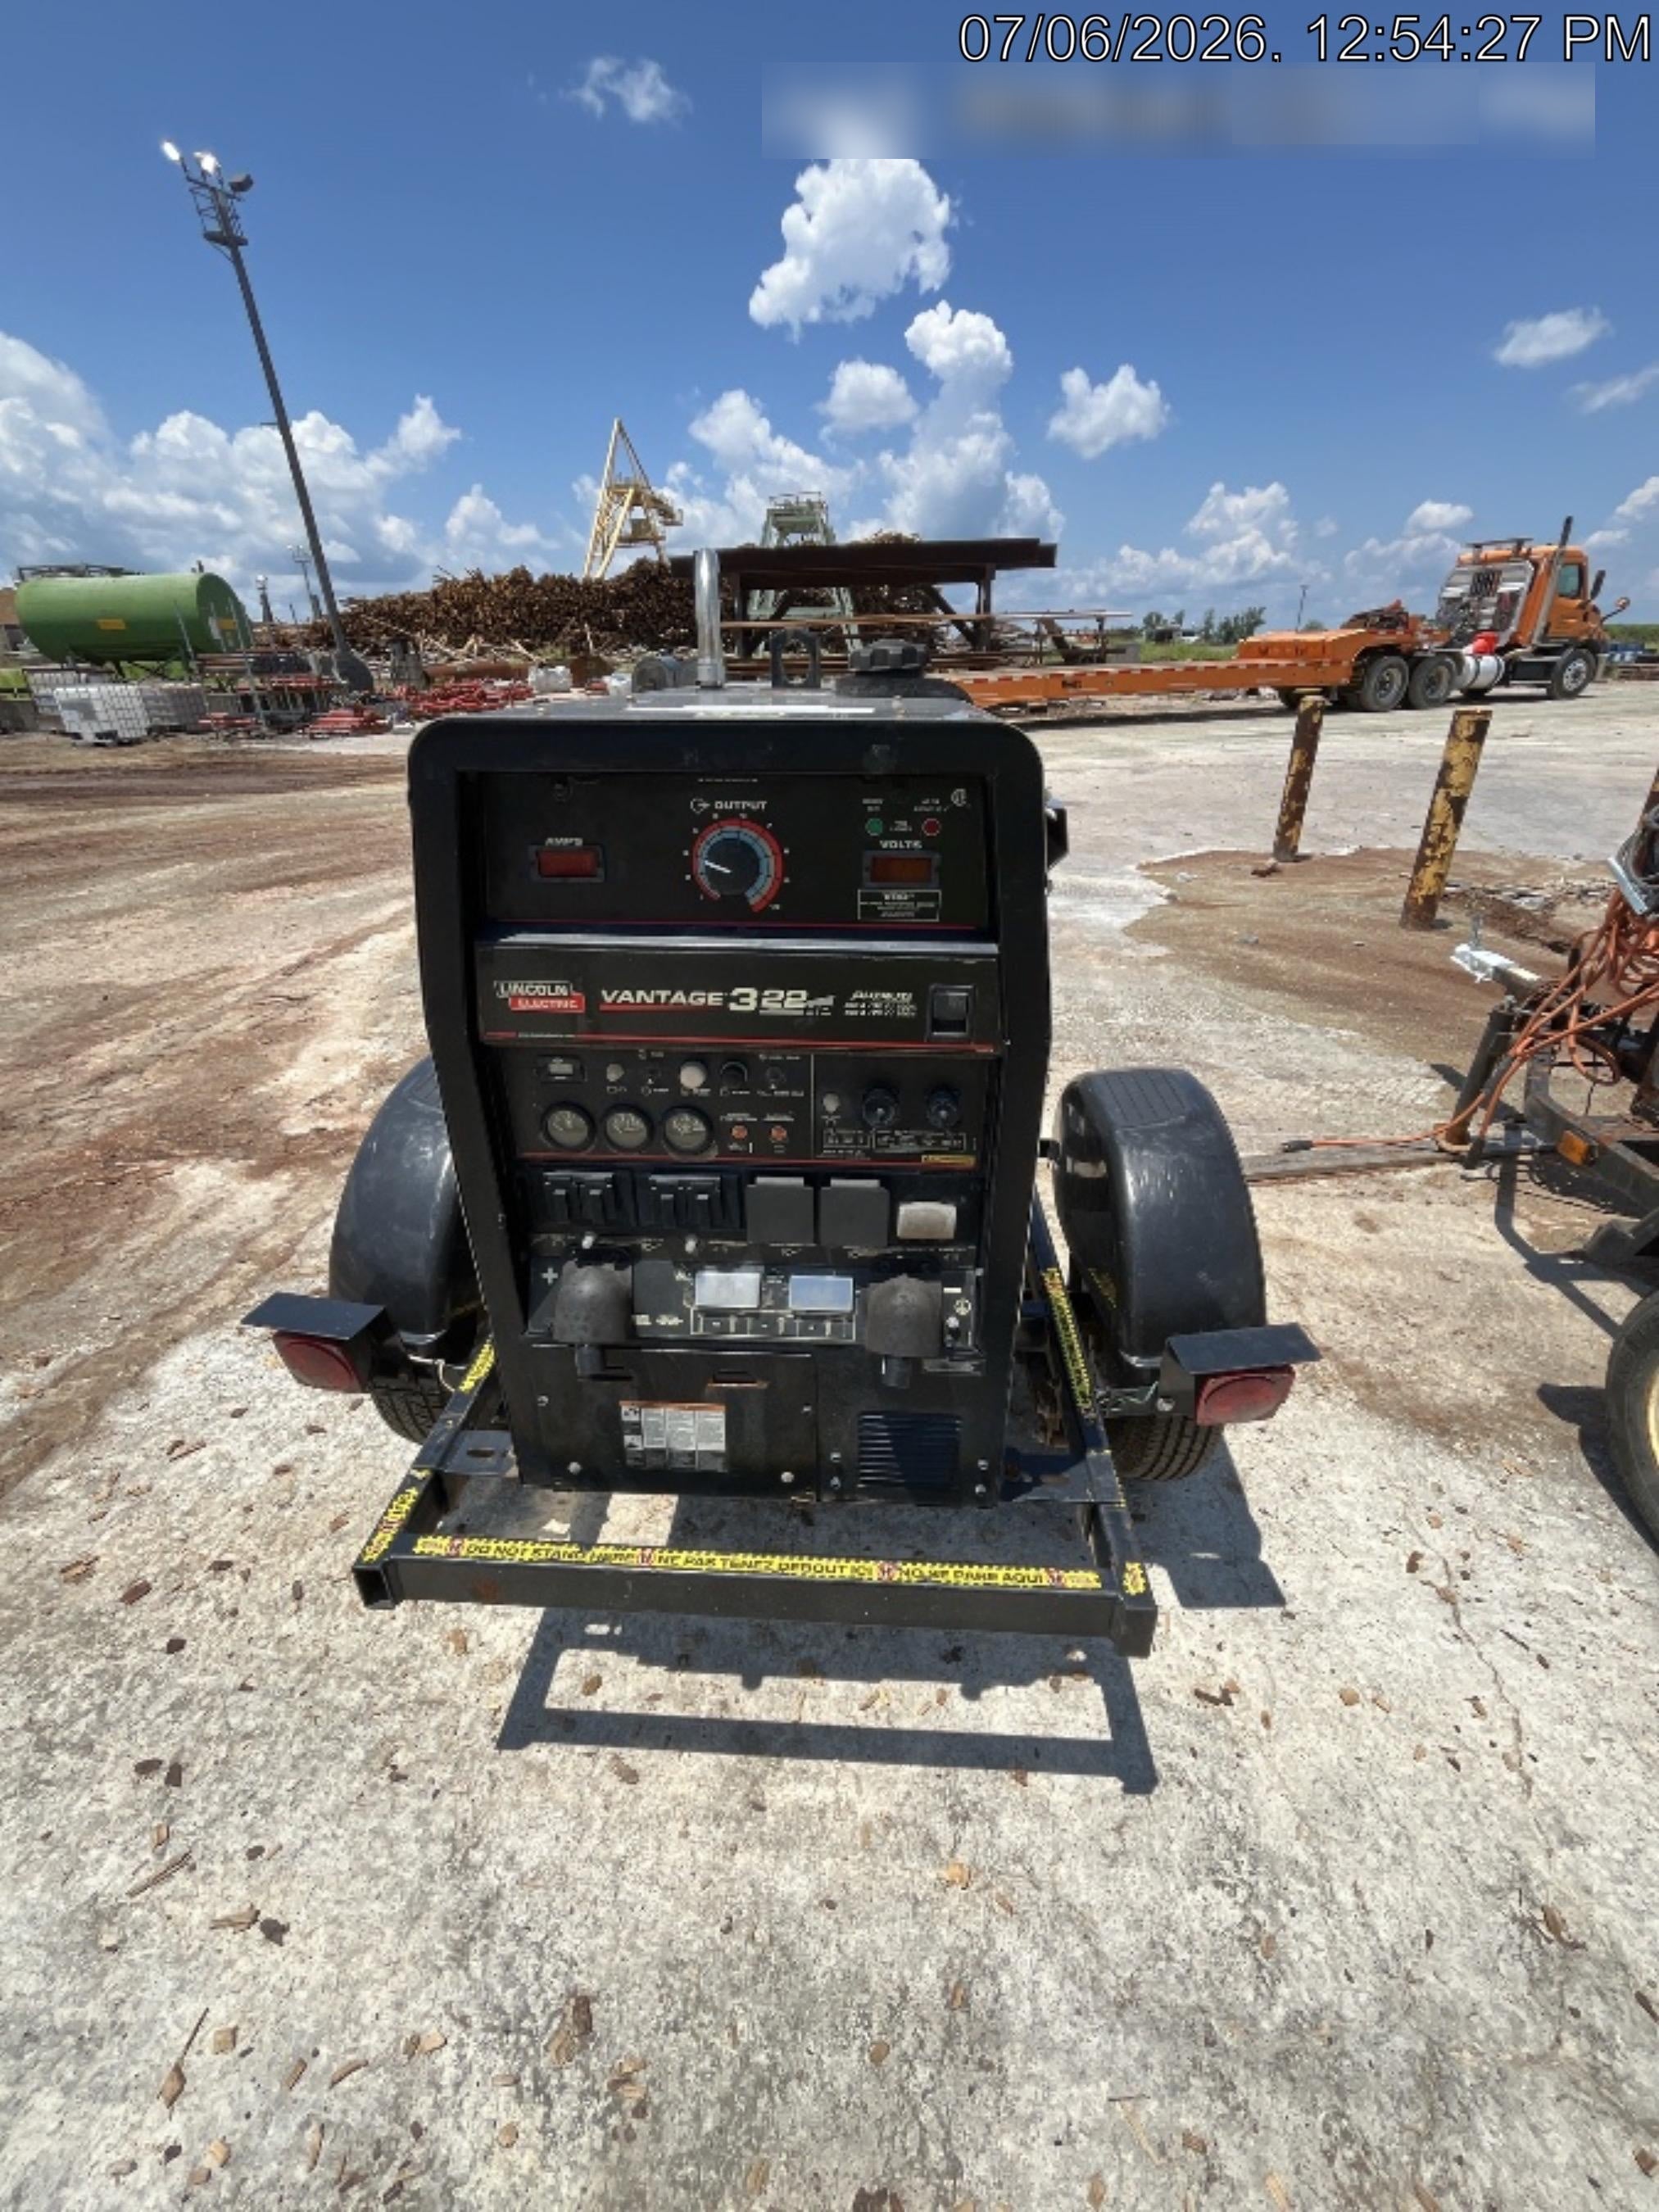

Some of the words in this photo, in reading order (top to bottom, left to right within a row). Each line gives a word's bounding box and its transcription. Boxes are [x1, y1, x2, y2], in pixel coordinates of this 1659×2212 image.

[714, 800, 768, 810] OUTPUT
[545, 837, 583, 846] AMPS
[879, 840, 922, 849] VOLTS
[496, 981, 569, 998] LINCOLN
[517, 998, 578, 1009] ELECTRIC
[601, 988, 723, 1006] VANTAGE
[728, 987, 808, 1011] 322
[466, 1544, 490, 1554] DO
[493, 1546, 528, 1556] NOT
